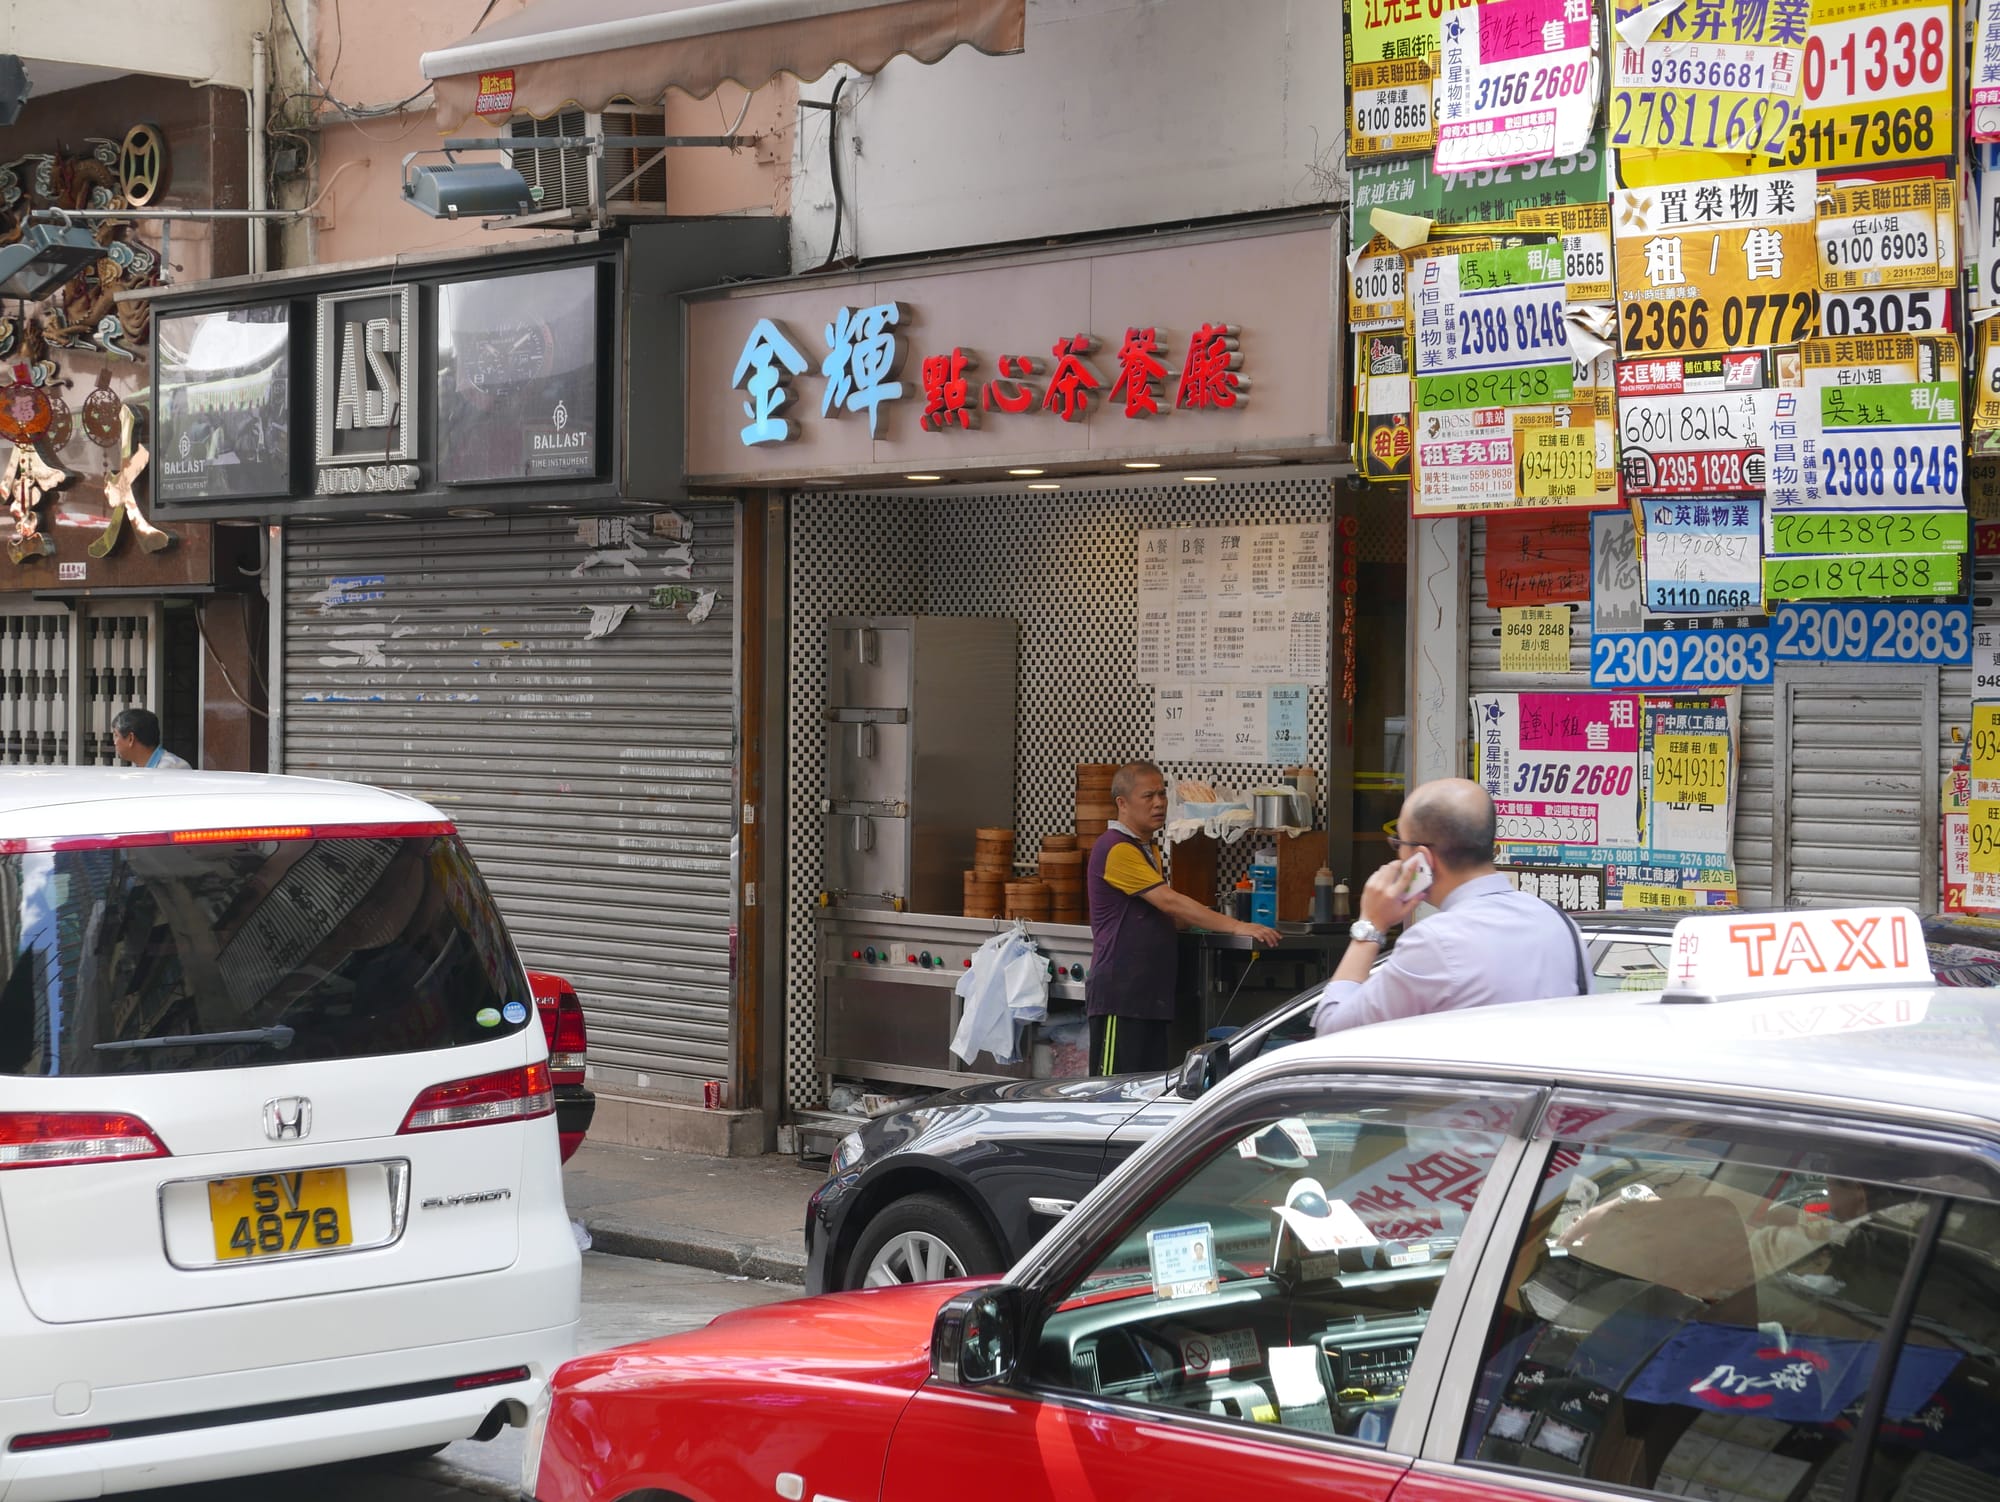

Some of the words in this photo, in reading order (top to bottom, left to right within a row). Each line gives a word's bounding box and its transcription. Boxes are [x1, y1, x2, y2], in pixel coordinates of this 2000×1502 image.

[1564, 0, 1589, 23] 租
[1541, 19, 1566, 51] 售
[1622, 47, 1645, 75] 租
[1651, 59, 1765, 89] 93636681
[1771, 51, 1795, 83] 售
[1377, 89, 1408, 105] 梁偉達
[1447, 48, 1463, 119] 宏星物業
[1474, 71, 1530, 111] 3156
[1530, 61, 1588, 102] 2680
[1358, 107, 1389, 131] 8100
[1394, 104, 1426, 129] 8565
[1612, 91, 1790, 154] 27811682
[1355, 139, 1365, 151] 租
[1368, 137, 1377, 150] 售
[1769, 105, 1933, 168] 311-7368
[1356, 178, 1415, 208] 歡迎查詢
[1661, 179, 1796, 225] 置榮物業
[1852, 216, 1900, 235] 任小姐
[1566, 252, 1605, 277] 8565
[1644, 236, 1686, 287] 租
[1742, 228, 1784, 281] 售
[1827, 237, 1873, 265] 8100
[1881, 232, 1928, 261] 6903
[1355, 274, 1387, 299] 8100
[1825, 272, 1838, 288] 租
[1844, 270, 1857, 286] 售
[1419, 288, 1443, 368] 恒昌物業
[1460, 305, 1509, 355] 2388
[1515, 300, 1567, 351] 8246
[1625, 298, 1709, 351] 2366
[1723, 292, 1813, 347] 0772
[1827, 292, 1932, 337] 0305
[733, 301, 903, 446] 金輝
[920, 322, 1241, 432] 點心茶餐廳
[1424, 370, 1549, 407] 60189488
[1620, 361, 1682, 384] 天匡物業
[1837, 369, 1882, 386] 任小姐
[1625, 407, 1673, 443] 6801
[1680, 405, 1737, 441] 8212
[533, 431, 587, 450] BALLAST
[1423, 441, 1509, 466] 租客免佣
[164, 459, 206, 475] BALLAST
[531, 458, 546, 469] TIME
[548, 456, 589, 467] INSTRUMENT
[1526, 450, 1594, 479] 93419313
[1622, 456, 1651, 488] 租
[1658, 455, 1697, 487] 2395
[1702, 453, 1741, 485] 1828
[1769, 421, 1803, 505] 恒昌物業
[1823, 447, 1884, 496] 2388
[1893, 444, 1958, 496] 8246
[315, 467, 361, 496] AUTO
[365, 465, 412, 492] SHOP
[1548, 485, 1576, 496] 謝小姐
[1675, 505, 1749, 527] 英聯物業
[1776, 515, 1941, 547] 96438936
[1773, 559, 1931, 592] 60189488
[1656, 587, 1699, 606] 3110
[1706, 589, 1750, 608] 0668
[1507, 623, 1533, 636] 9649
[1538, 623, 1565, 636] 2848
[1662, 615, 1750, 631] 全日熱線
[1776, 608, 1868, 657] 2309
[1871, 609, 1968, 660] 2883
[1594, 636, 1679, 684] 2309
[1682, 633, 1769, 682] 2883
[1609, 700, 1635, 729] 租
[1584, 721, 1610, 750] 售
[1486, 729, 1502, 797] 宏星物業
[1513, 762, 1571, 794] 3156
[1571, 764, 1634, 796] 2680
[1656, 756, 1726, 788] 93419313
[1678, 790, 1707, 802] 謝小姐
[1591, 849, 1614, 861] 2576
[1616, 849, 1638, 862] 8081
[1680, 853, 1702, 866] 2576
[1677, 933, 1699, 978] 的士
[1729, 916, 1909, 978] TAXI
[252, 1172, 304, 1214] SV
[229, 1206, 340, 1255] 4878
